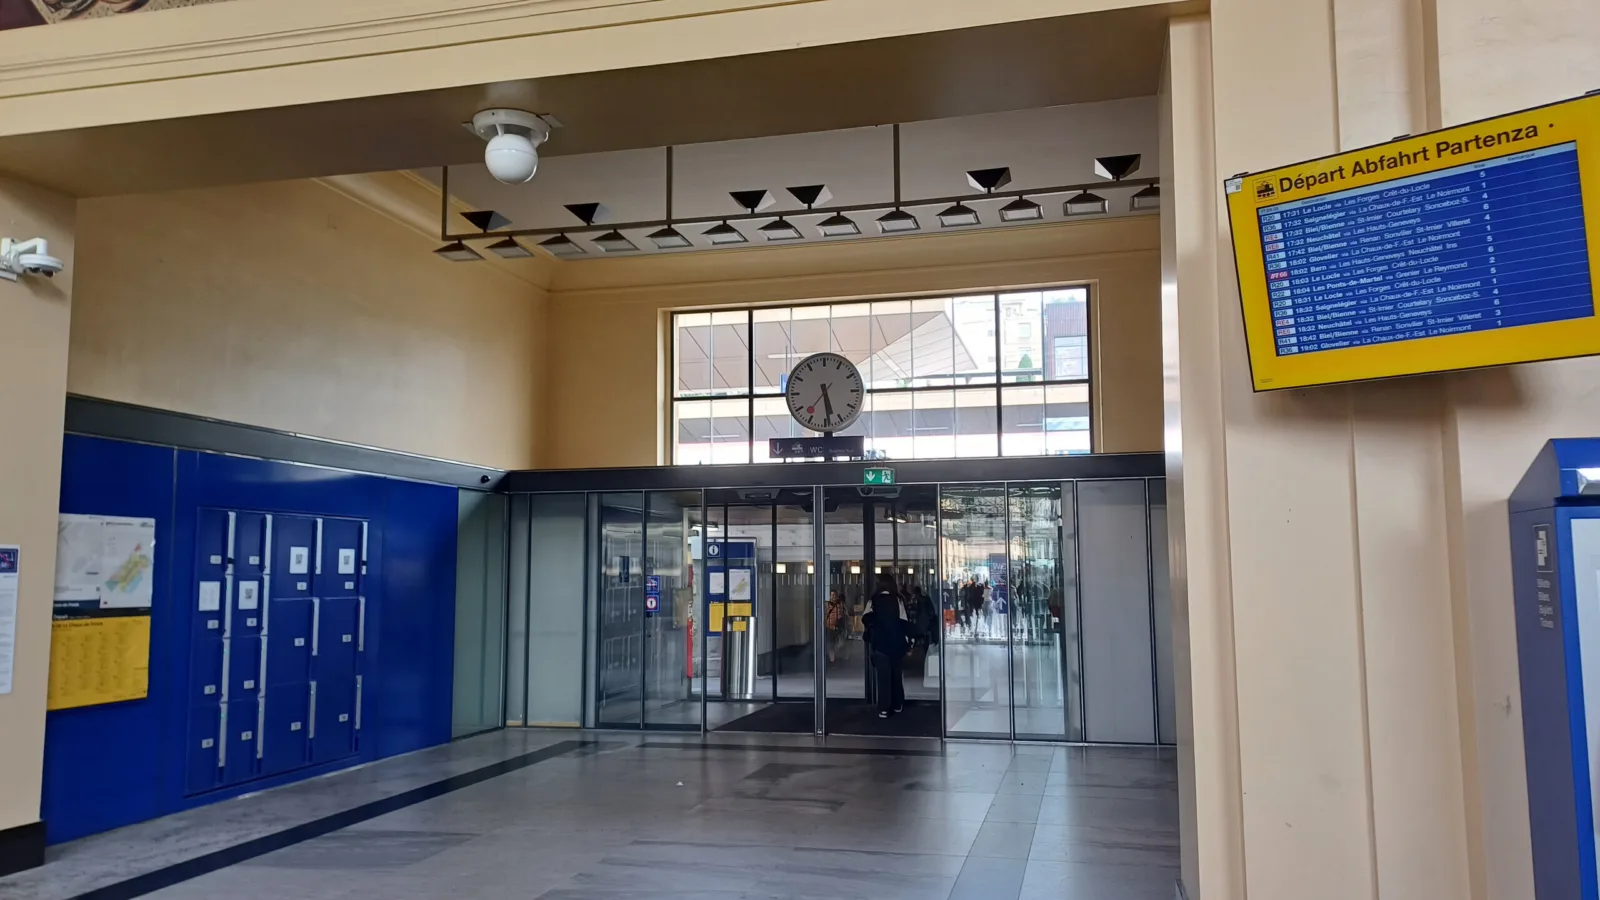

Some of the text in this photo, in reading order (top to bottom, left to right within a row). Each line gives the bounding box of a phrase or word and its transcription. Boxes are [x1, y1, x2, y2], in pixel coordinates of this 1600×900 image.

[1279, 124, 1539, 193] Départ Abfahrt Partenza
[1282, 209, 1299, 218] 17:31
[1312, 202, 1331, 212] Locle
[1344, 197, 1355, 205] Les
[1357, 192, 1379, 204] Forges
[1479, 170, 1485, 178] 5
[1284, 219, 1301, 227] 17:32
[1304, 210, 1345, 225] Saignelégier
[1436, 185, 1469, 197] Noirmont
[1285, 228, 1302, 237] 17:32
[1305, 220, 1344, 234] Biel/Bienne
[1357, 213, 1382, 223] St-Imier
[1386, 205, 1421, 219] Courtelary
[1286, 238, 1304, 246] 17:32
[1306, 231, 1340, 243] Neuchâtel
[1353, 226, 1364, 234] Les
[1366, 216, 1421, 233] Hauts-Geneveys
[1482, 202, 1489, 210] 6
[1288, 248, 1305, 256] 17:42
[1307, 240, 1347, 254] Biel/Bienne
[1359, 234, 1380, 243] Renan
[1416, 222, 1443, 233] St-Imier
[1289, 257, 1306, 266] 18:02
[1308, 252, 1338, 262] Glovelier
[1428, 230, 1460, 241] Noirmont
[1290, 267, 1307, 275] 18:02
[1310, 264, 1326, 272] Bern
[1352, 250, 1405, 266] Hauts-Geneveys
[1408, 244, 1442, 255] Neuchâtel
[1486, 234, 1493, 242] 5
[1291, 277, 1309, 285] 18:03
[1321, 271, 1340, 280] Locle
[1352, 267, 1364, 275] Les
[1365, 263, 1388, 274] Forges
[1293, 286, 1310, 294] 18:04
[1326, 274, 1382, 289] Ponts-de-Martel
[1395, 268, 1420, 278] Grenier
[1294, 296, 1310, 304] 18:31
[1324, 291, 1342, 299] Locle
[1368, 283, 1390, 294] Forges
[1295, 305, 1312, 313] 18:32
[1315, 299, 1357, 311] Saignelégier
[1448, 280, 1480, 290] Noirmont
[1296, 315, 1314, 323] 18:32
[1316, 309, 1356, 321] Biel/Bienne
[1368, 303, 1393, 312] St-Imier
[1397, 298, 1432, 309] Courtelary
[1298, 324, 1315, 332] 18:32
[1317, 319, 1351, 329] Neuchâtel
[1377, 308, 1432, 322] Hauts-Geneveys
[1319, 328, 1358, 340] Biel/Bienne
[1370, 324, 1391, 332] Renan
[1427, 315, 1454, 324] St-Imier
[1320, 339, 1349, 348] Glovelier
[1439, 323, 1471, 333] Noirmont
